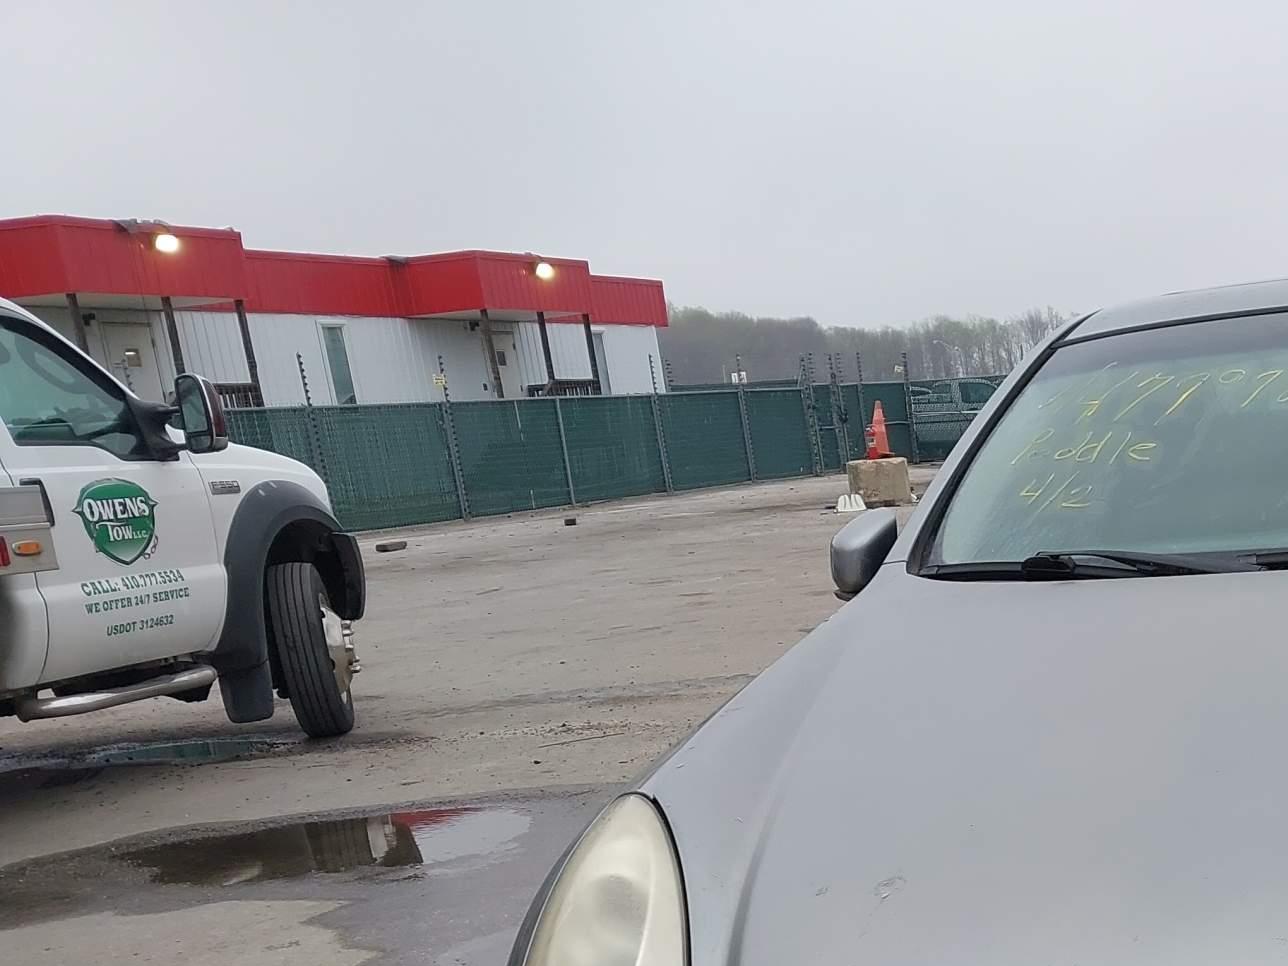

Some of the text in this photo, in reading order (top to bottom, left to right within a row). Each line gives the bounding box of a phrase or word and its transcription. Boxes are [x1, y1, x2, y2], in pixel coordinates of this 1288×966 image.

[82, 496, 149, 522] OWENS
[80, 569, 185, 597] CALL: 410.777.5534
[84, 587, 190, 615] WE OFFER 24/7 SERVICE
[106, 614, 175, 637] USDOT 3124632
